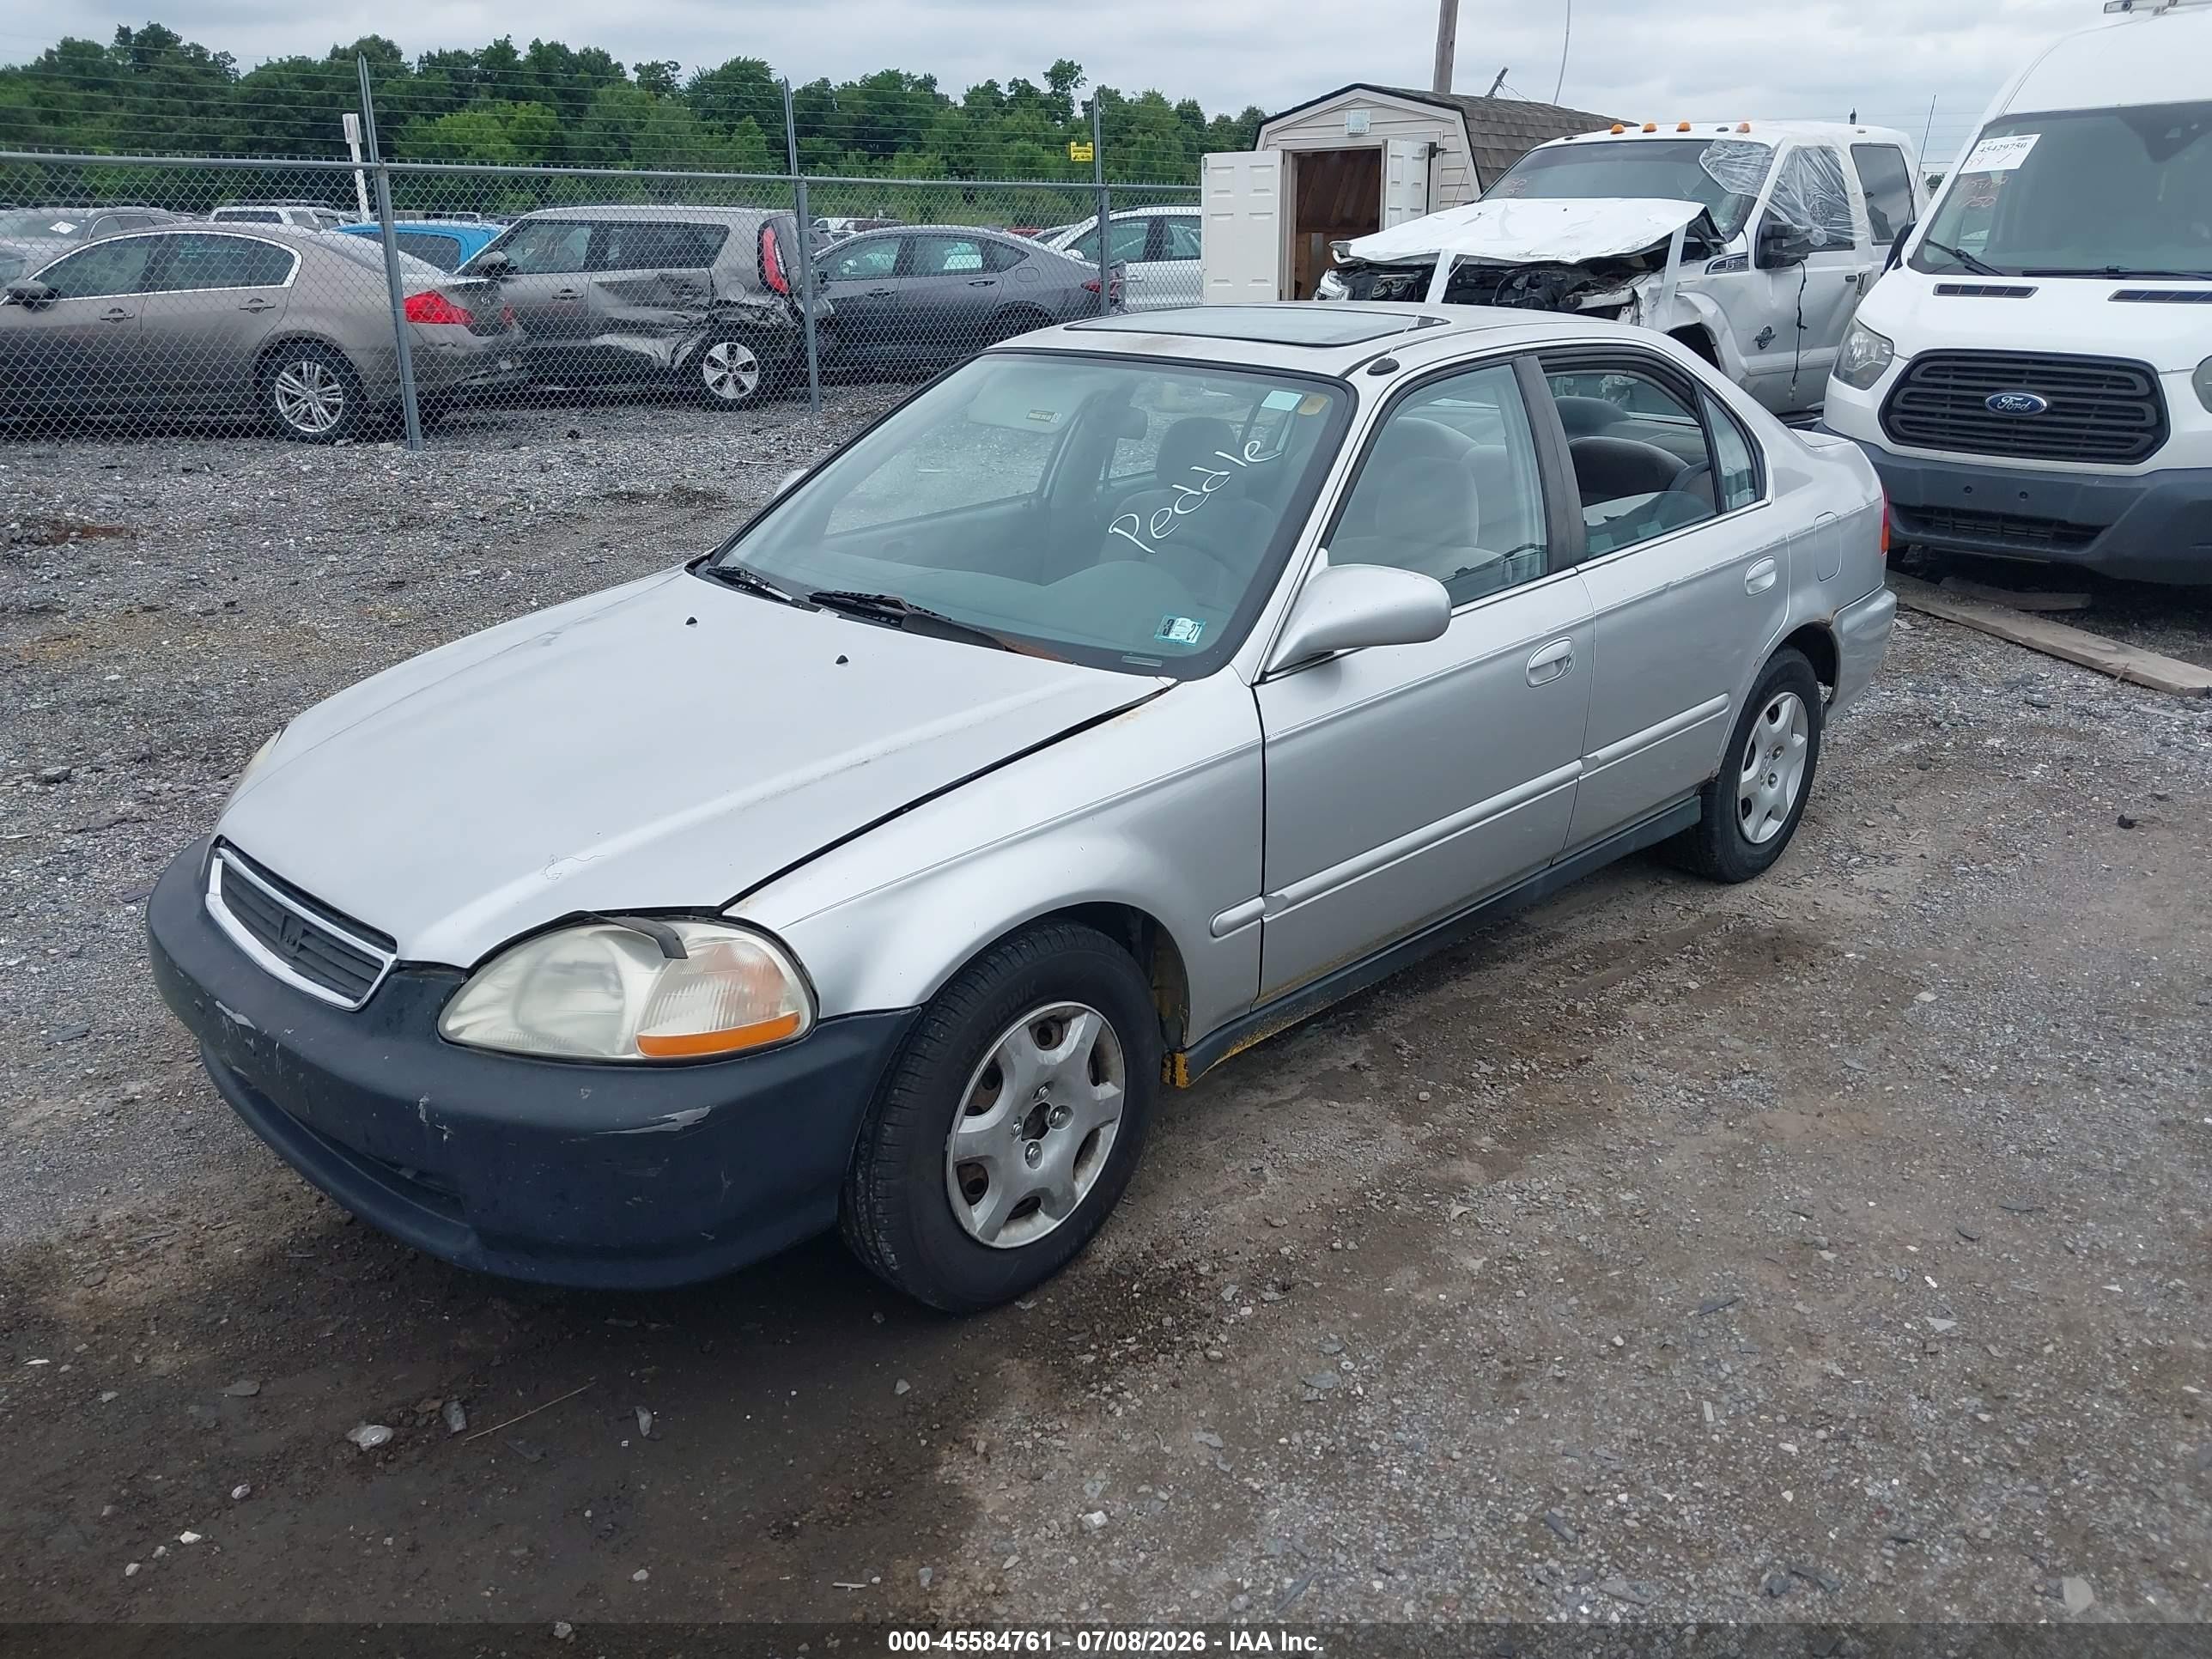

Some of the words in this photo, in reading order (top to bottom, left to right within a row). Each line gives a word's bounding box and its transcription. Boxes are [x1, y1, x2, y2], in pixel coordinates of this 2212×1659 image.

[1996, 396, 2031, 411] Ford
[1108, 440, 1282, 554] Peddle
[1163, 618, 1175, 636] 3
[1187, 623, 1201, 641] 27
